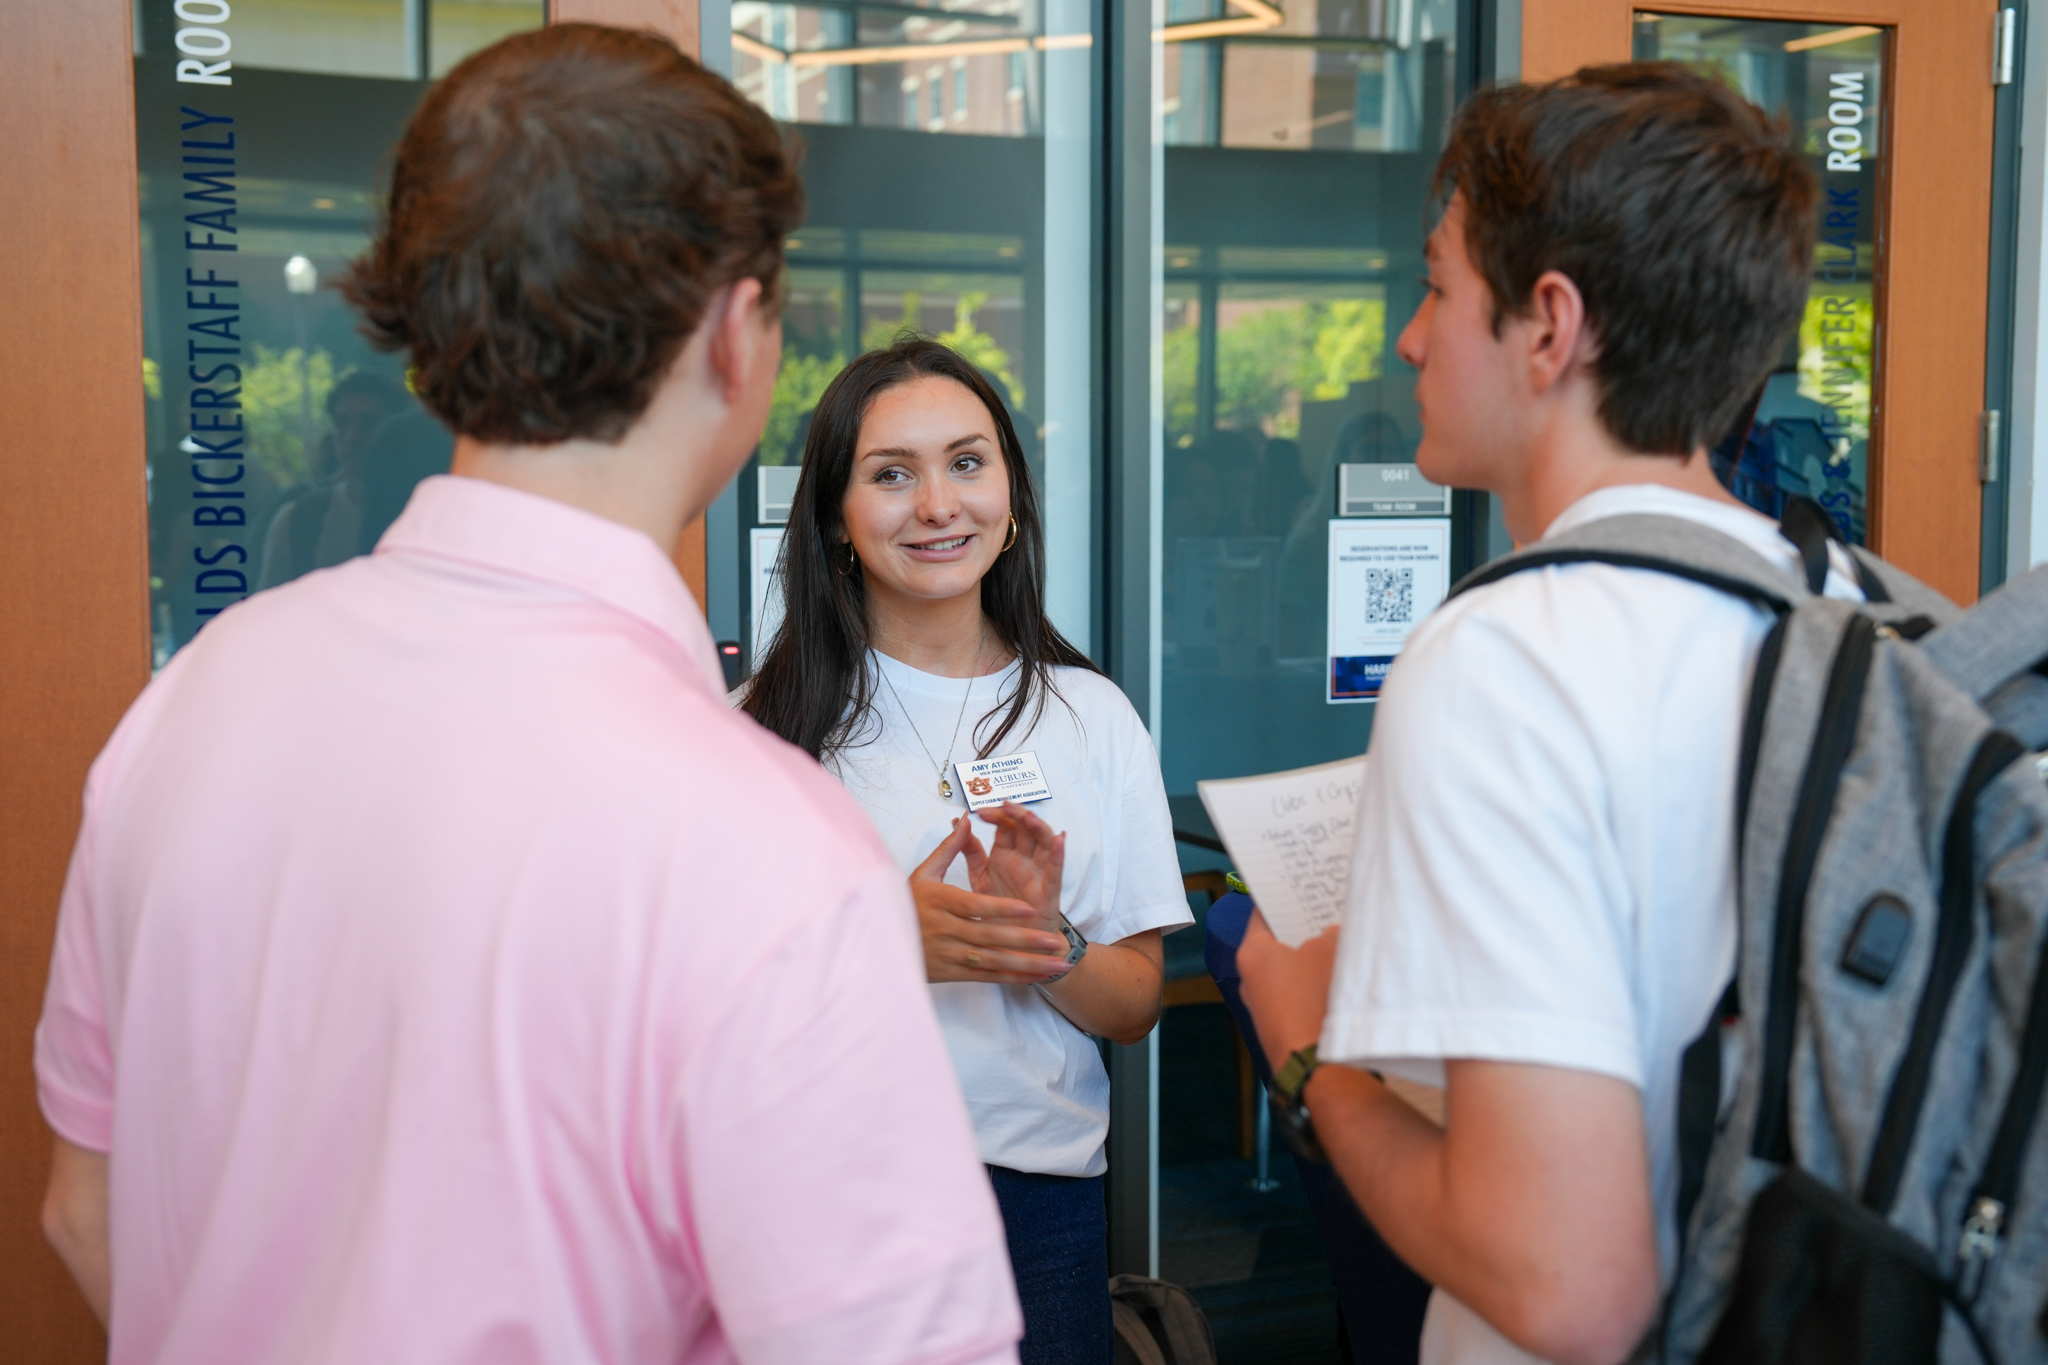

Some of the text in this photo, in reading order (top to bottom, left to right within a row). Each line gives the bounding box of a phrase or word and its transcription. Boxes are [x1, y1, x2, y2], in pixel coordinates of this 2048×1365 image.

[1826, 71, 1865, 172] ROOM
[180, 105, 238, 252] FAMILY
[1824, 187, 1860, 285] CLARK
[1821, 296, 1856, 447] JENNIFER
[186, 268, 246, 526] BICKERSTAFF
[1381, 468, 1410, 482] 0041
[1822, 459, 1851, 480] &
[1372, 502, 1417, 511] TEAM ROOM
[972, 758, 1023, 772] AMY ATHING
[992, 766, 1019, 774] PRESIDENT
[993, 770, 1036, 784] AUBURN
[1001, 781, 1033, 789] UNIVERSITY
[997, 793, 1023, 801] MANAGEMENT
